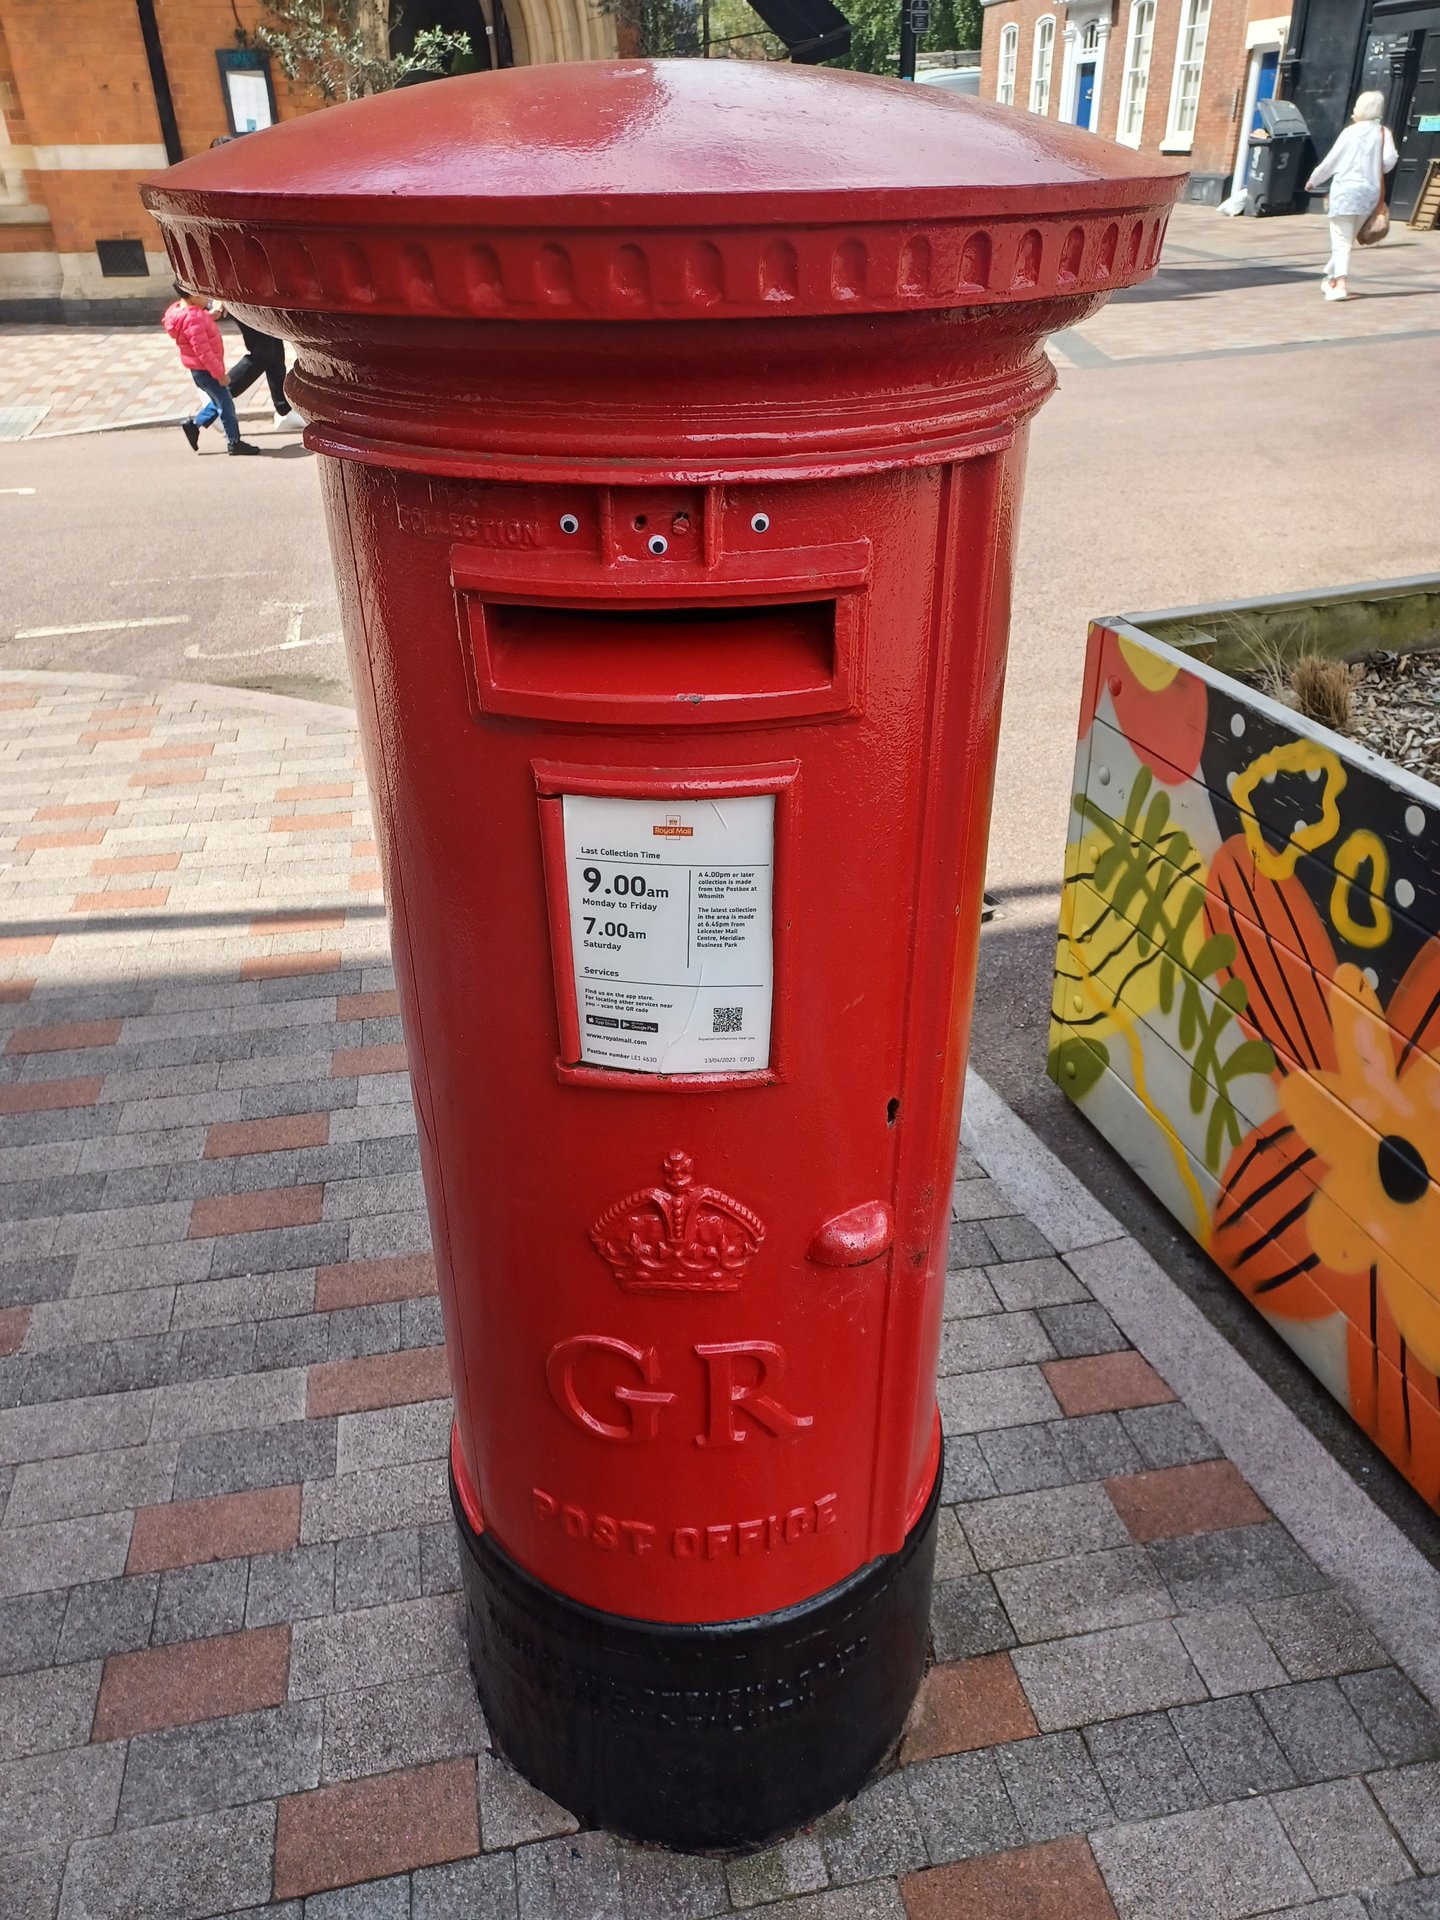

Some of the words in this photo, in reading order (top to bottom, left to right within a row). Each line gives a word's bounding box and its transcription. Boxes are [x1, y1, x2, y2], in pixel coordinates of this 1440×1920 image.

[654, 826, 674, 836] Royal
[676, 826, 692, 834] Mail
[581, 846, 598, 855] Last
[600, 848, 638, 858] Collection
[583, 867, 669, 898] 9.00am
[582, 898, 616, 908] Monday
[630, 902, 657, 912] Friday
[583, 917, 646, 939] 7.00am
[583, 940, 622, 951] Saturday
[584, 966, 619, 977] Services
[596, 996, 617, 1004] locating
[586, 1032, 647, 1045] www.royalmail.com
[587, 1048, 607, 1056] Postbox
[546, 1334, 814, 1448] GR
[532, 1488, 656, 1557] POST
[673, 1492, 838, 1560] OFFICE
